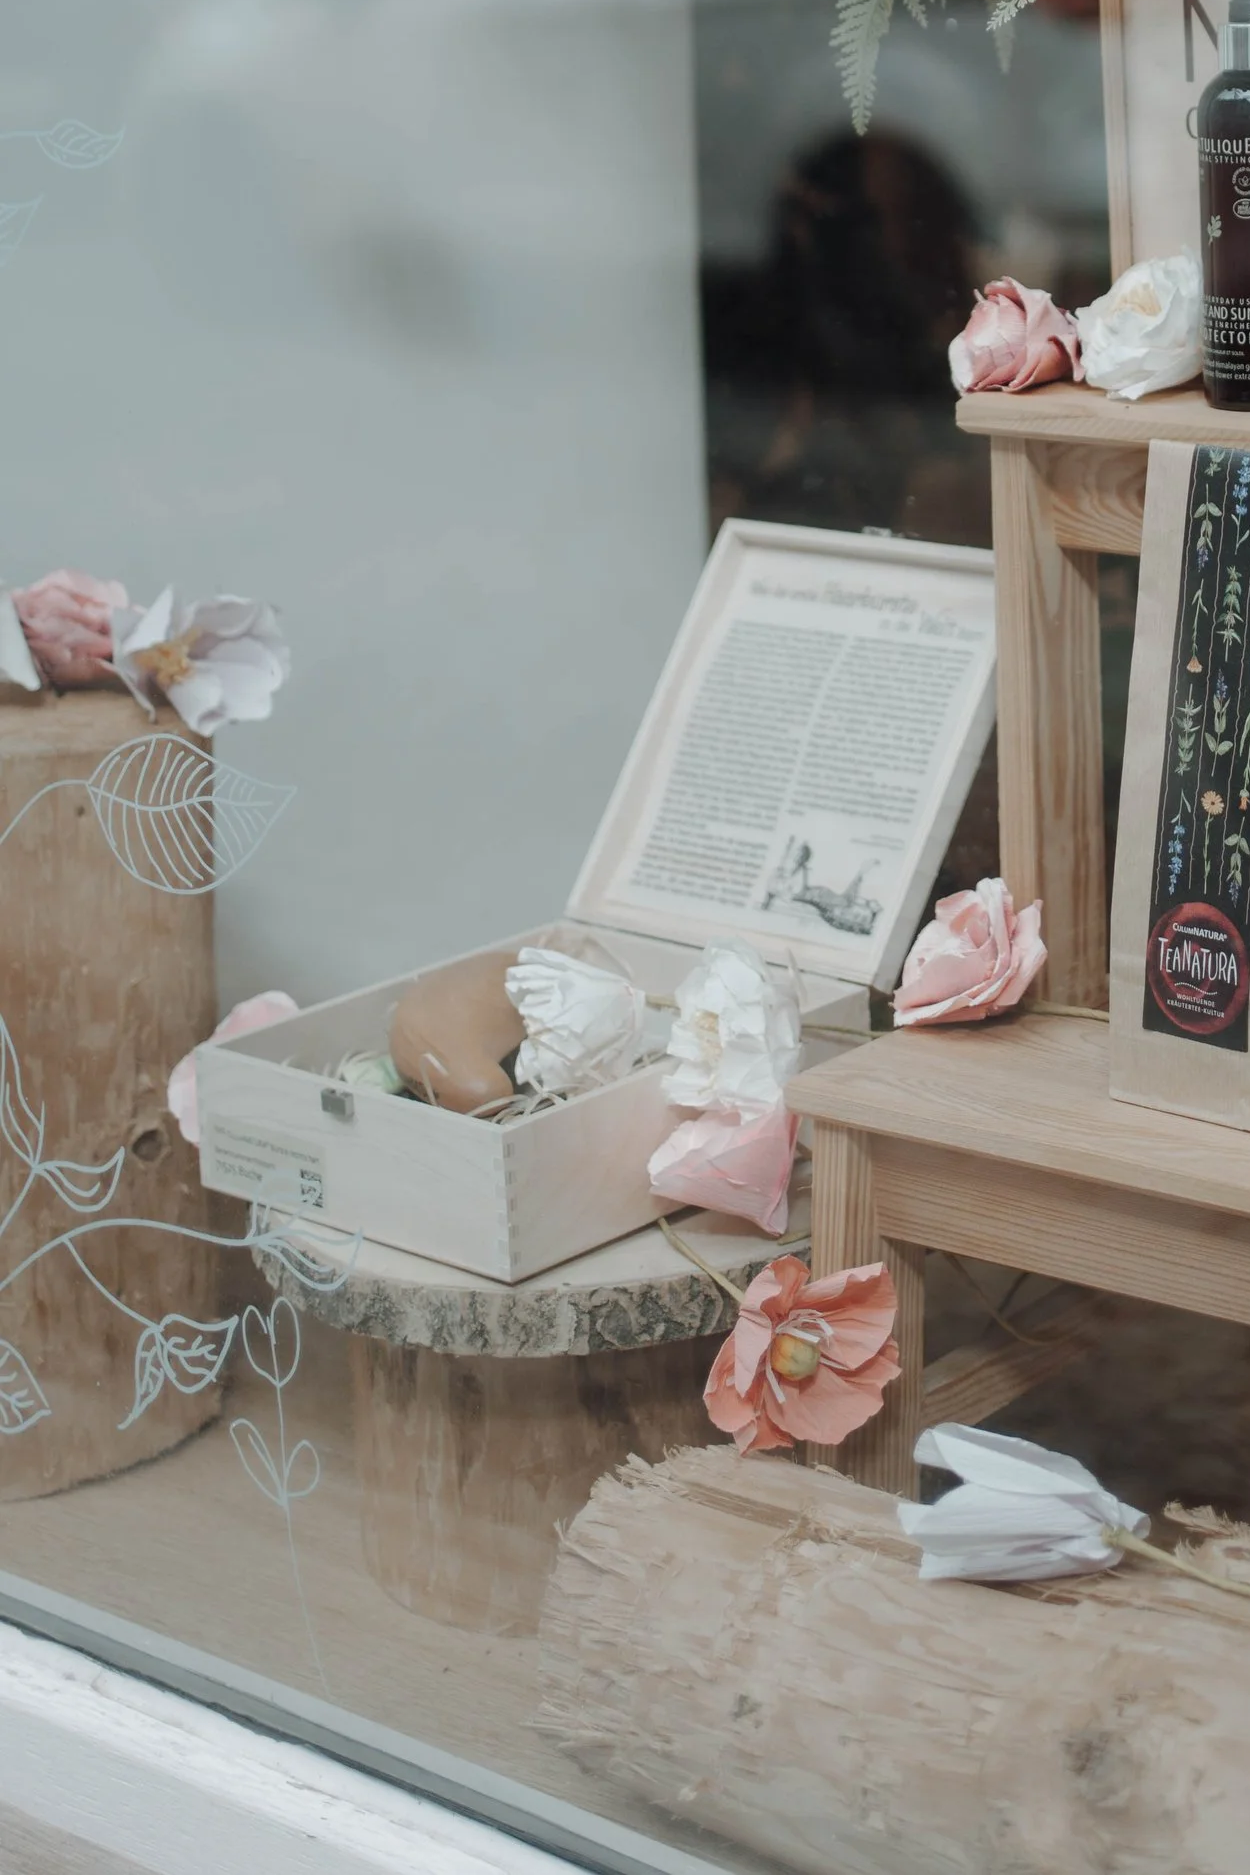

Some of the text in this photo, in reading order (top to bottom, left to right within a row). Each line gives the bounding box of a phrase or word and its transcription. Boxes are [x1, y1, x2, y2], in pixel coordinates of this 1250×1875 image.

[1209, 306, 1228, 319] AND
[1158, 936, 1238, 987] TEANATURA
[1176, 992, 1216, 1009] WOHLTUENDE
